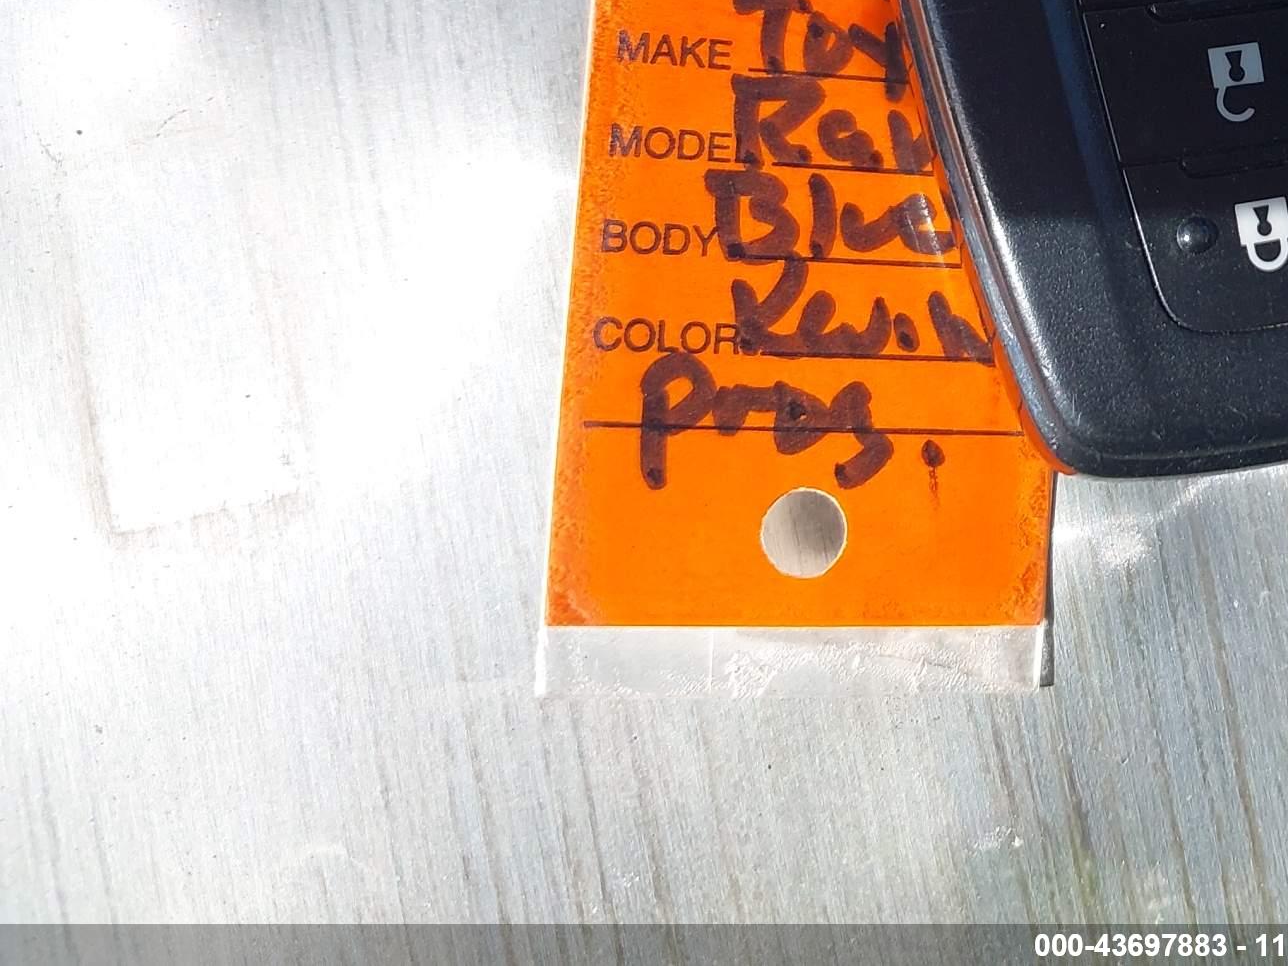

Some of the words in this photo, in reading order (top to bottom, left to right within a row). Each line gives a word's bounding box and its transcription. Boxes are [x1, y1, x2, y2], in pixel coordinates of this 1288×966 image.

[616, 29, 733, 70] MAKE
[601, 218, 720, 257] BODY
[593, 316, 741, 355] COLOR
